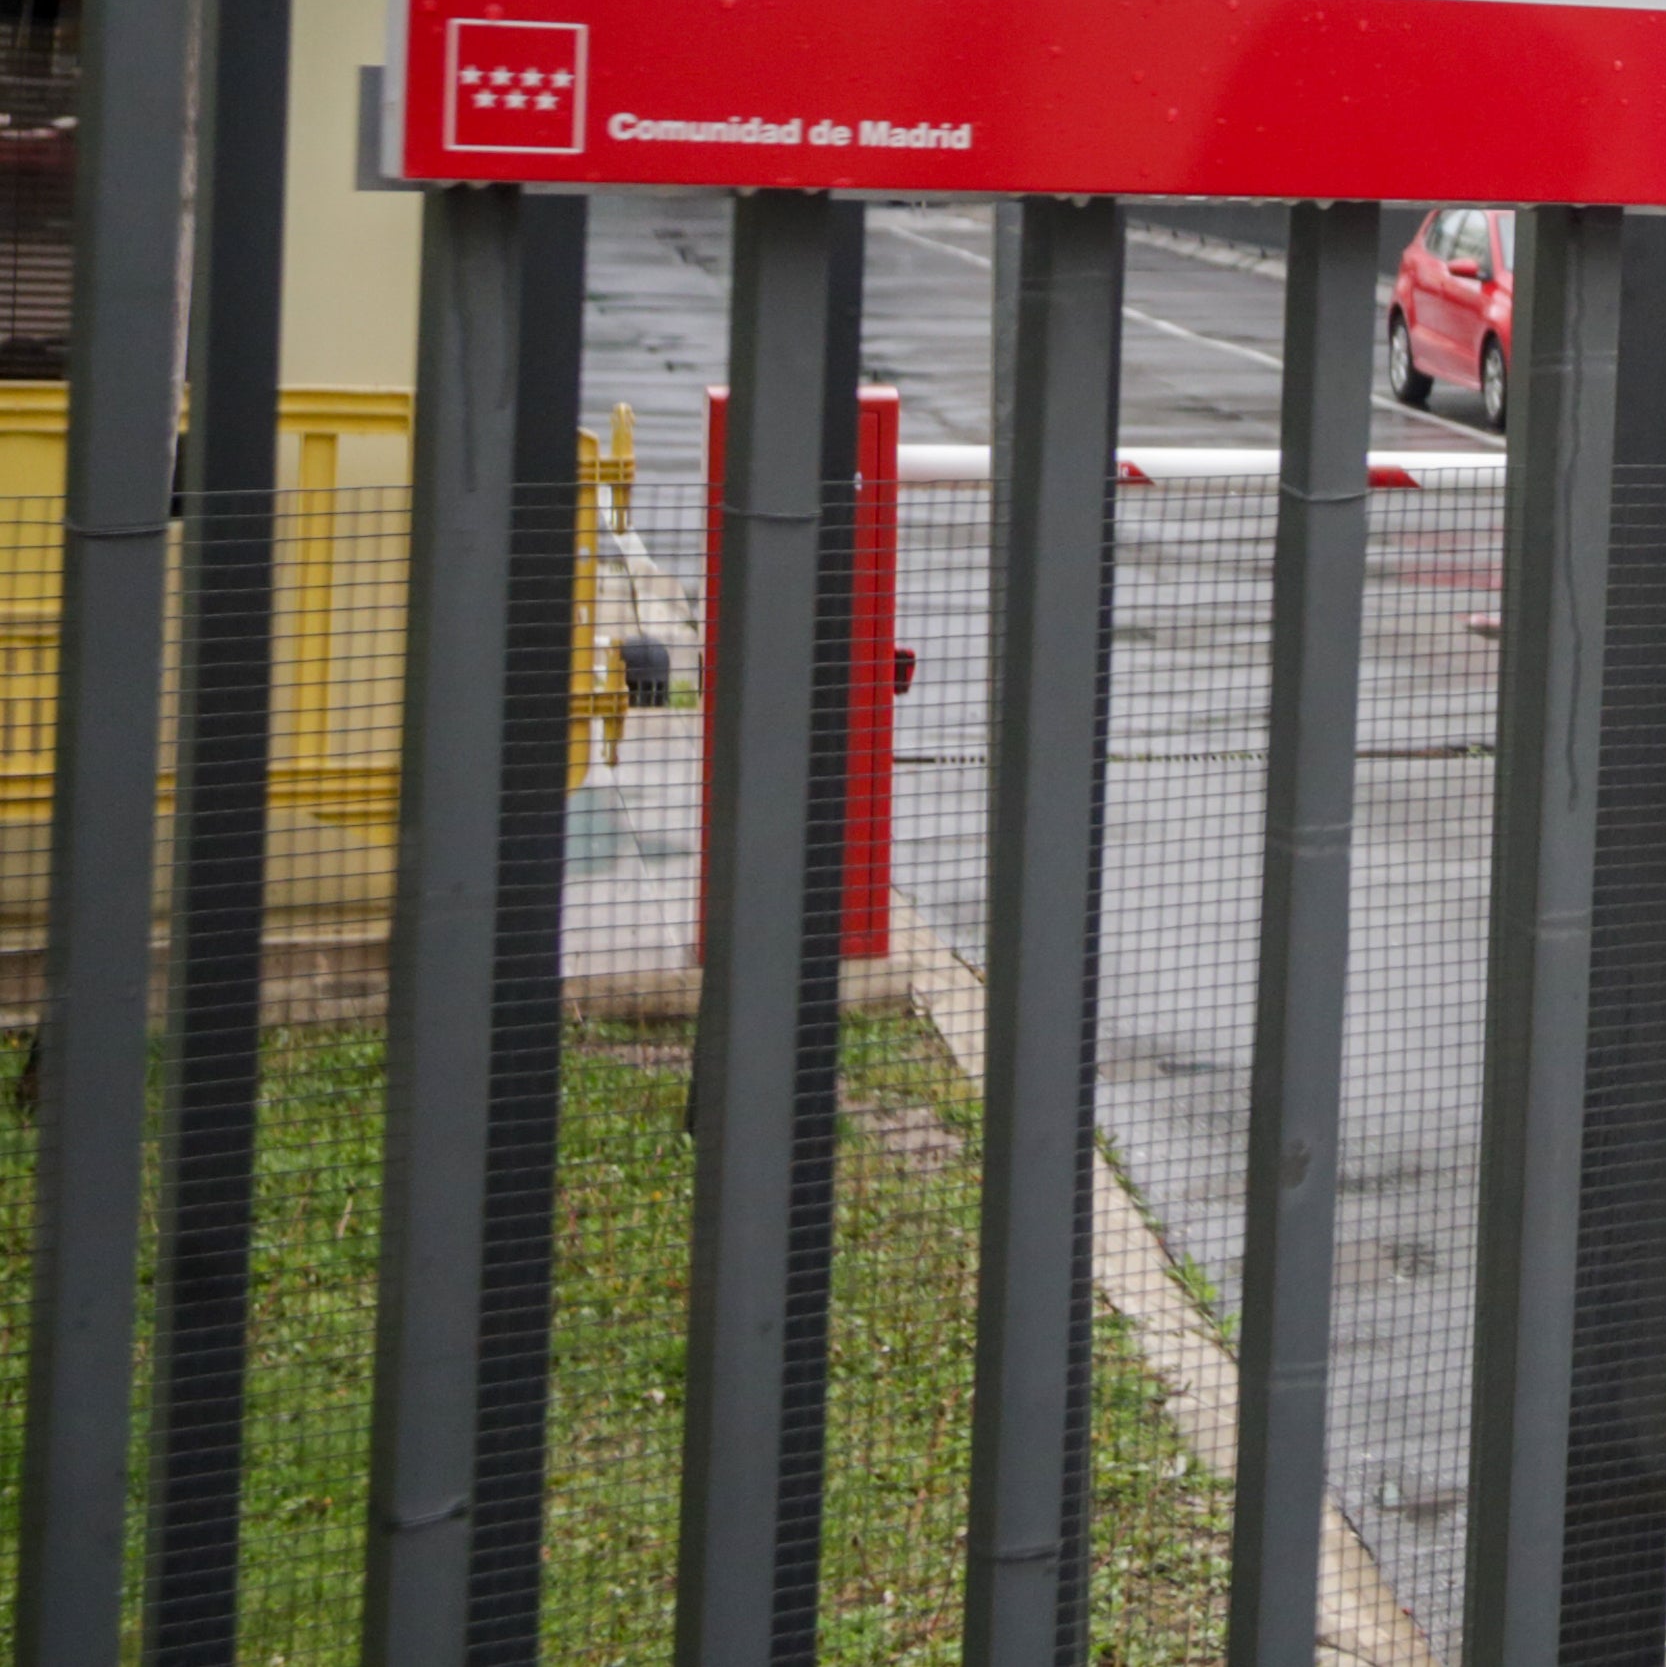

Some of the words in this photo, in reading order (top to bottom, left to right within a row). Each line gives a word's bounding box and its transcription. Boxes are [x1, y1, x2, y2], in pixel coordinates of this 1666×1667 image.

[607, 112, 802, 145] Comunidad
[809, 119, 852, 146] de
[858, 120, 972, 149] Madrid
